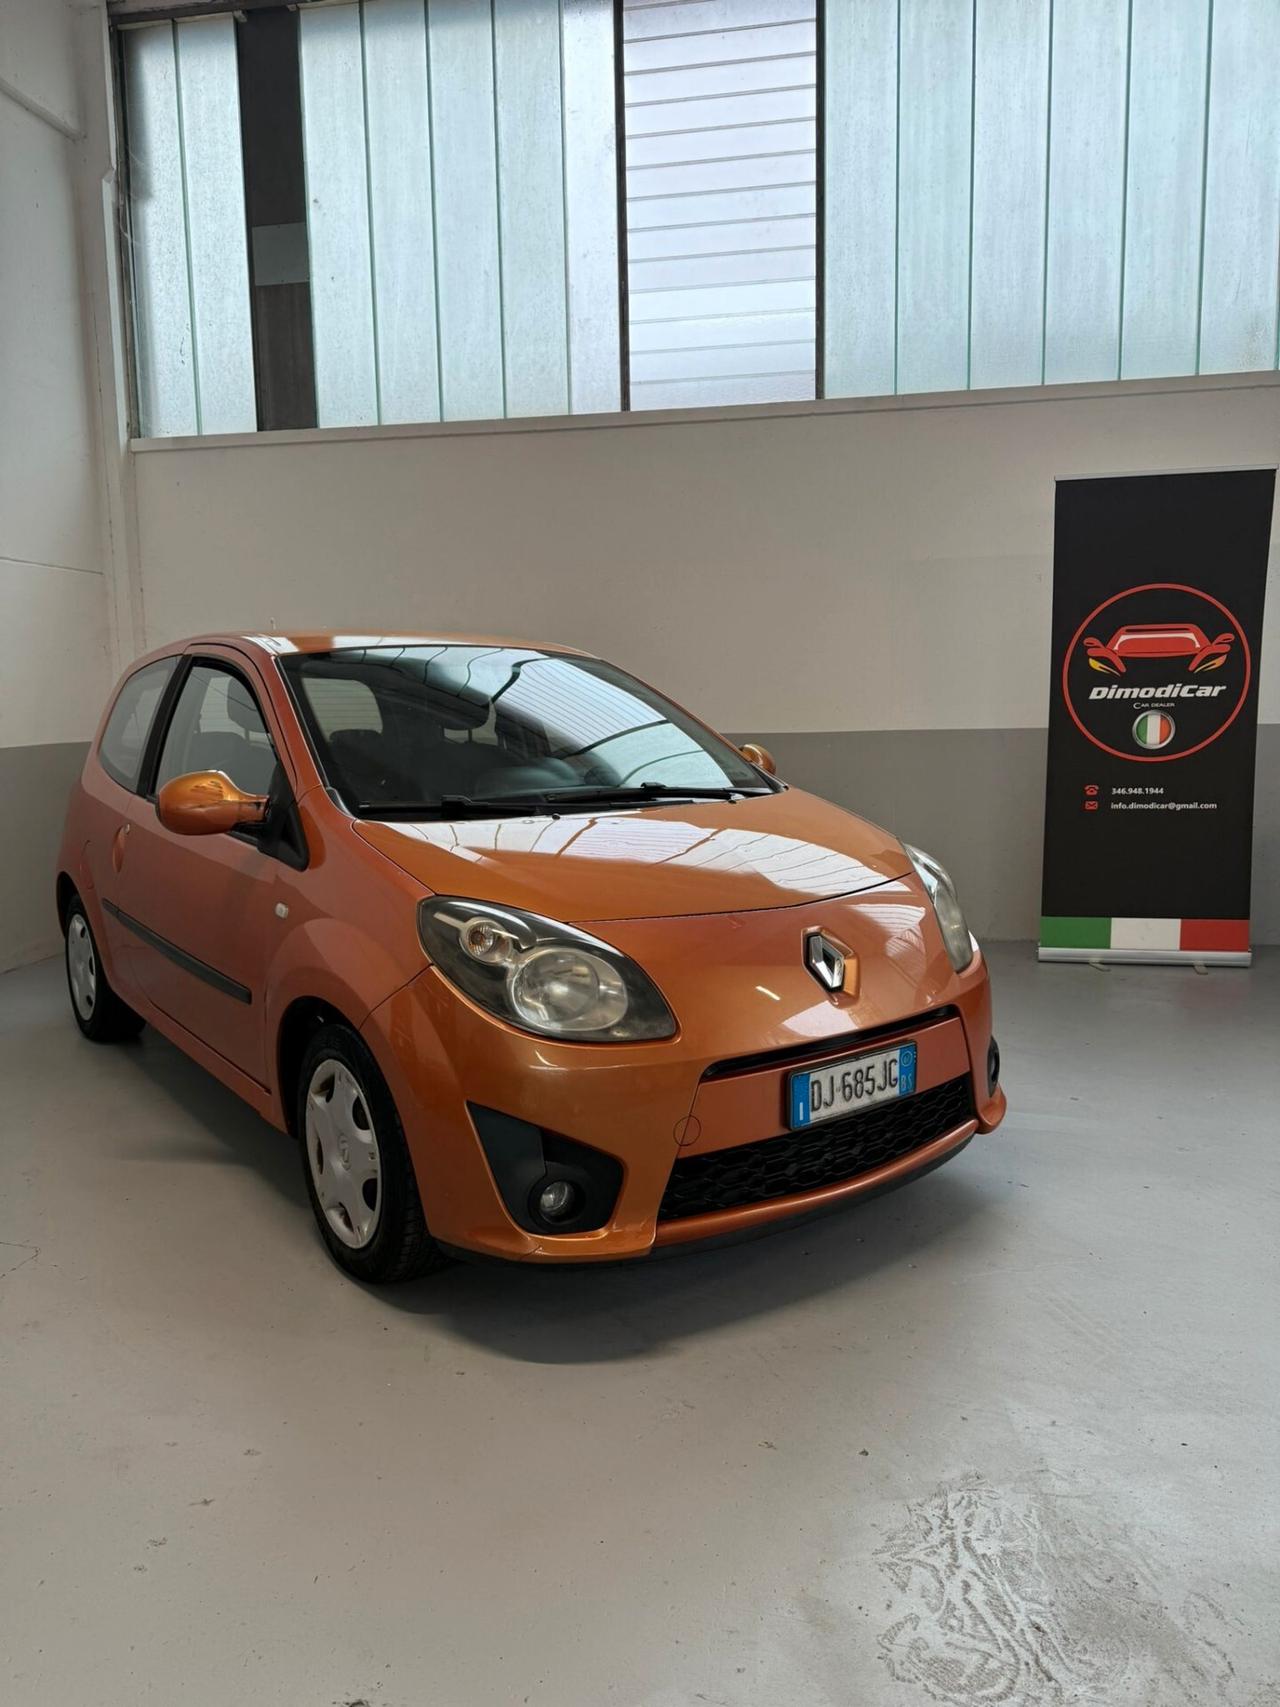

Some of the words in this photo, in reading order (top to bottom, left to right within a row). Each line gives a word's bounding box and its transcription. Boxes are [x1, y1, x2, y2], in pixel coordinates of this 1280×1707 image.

[1089, 683, 1227, 700] DimodiCar
[1112, 787, 1164, 795] 346.948.1944
[1111, 802, 1217, 811] info.dimodicar@gmail.com
